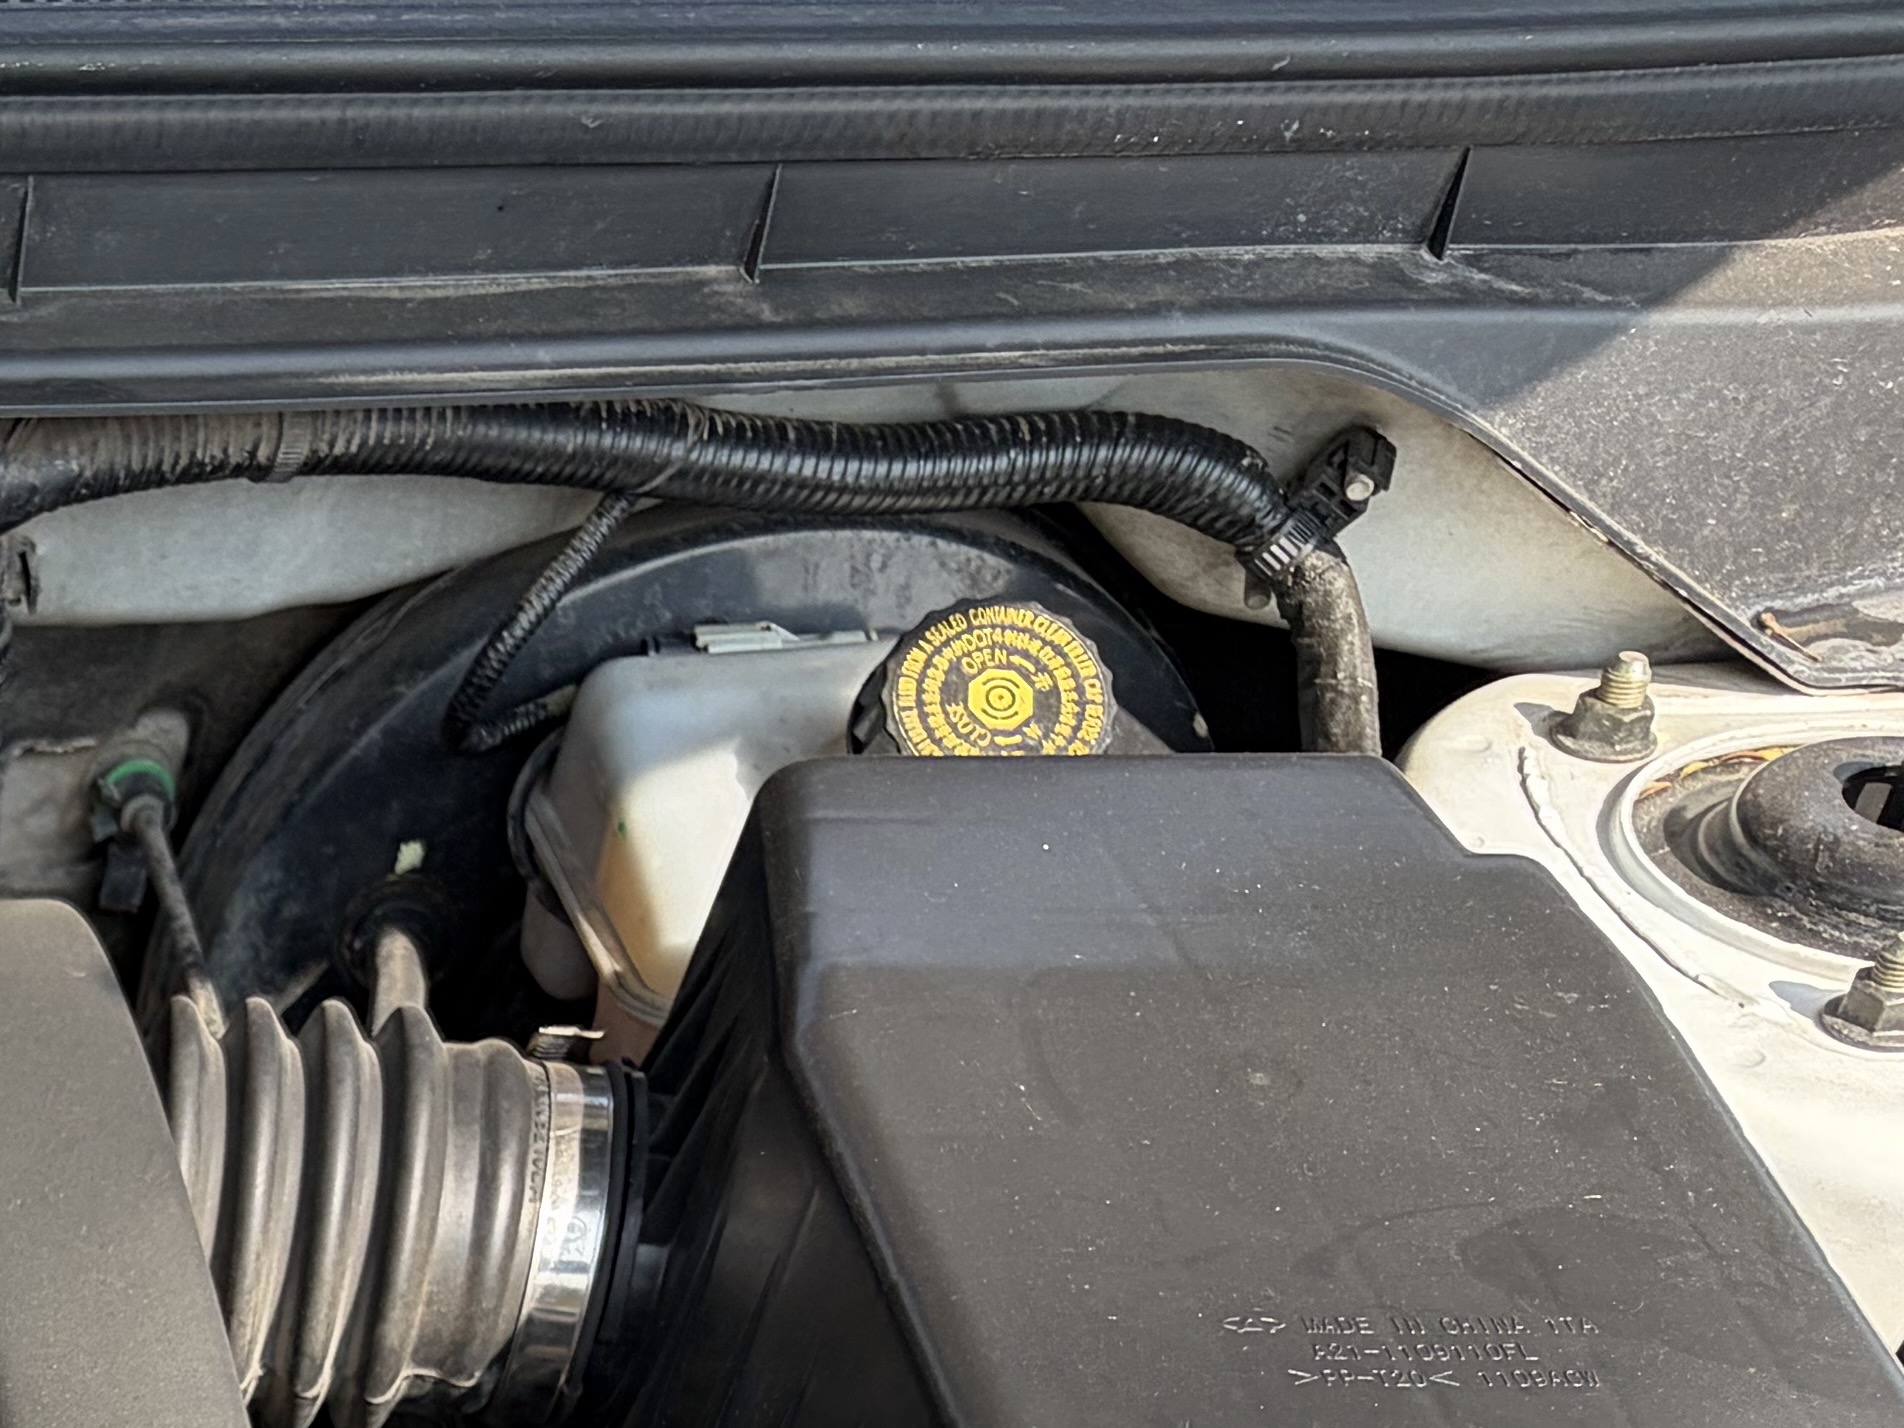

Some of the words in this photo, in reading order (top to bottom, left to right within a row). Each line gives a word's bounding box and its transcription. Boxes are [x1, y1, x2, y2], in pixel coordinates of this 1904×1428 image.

[969, 606, 1035, 628] CONTAINER
[925, 613, 968, 647] SEALED
[919, 640, 934, 653] A
[962, 649, 1007, 675] OPEN
[946, 701, 991, 747] CLOSE
[1301, 1316, 1375, 1335] MADE
[1392, 1316, 1426, 1335] IN
[1439, 1316, 1531, 1335] CHINA
[1312, 1343, 1539, 1362] A21-1109110FL
